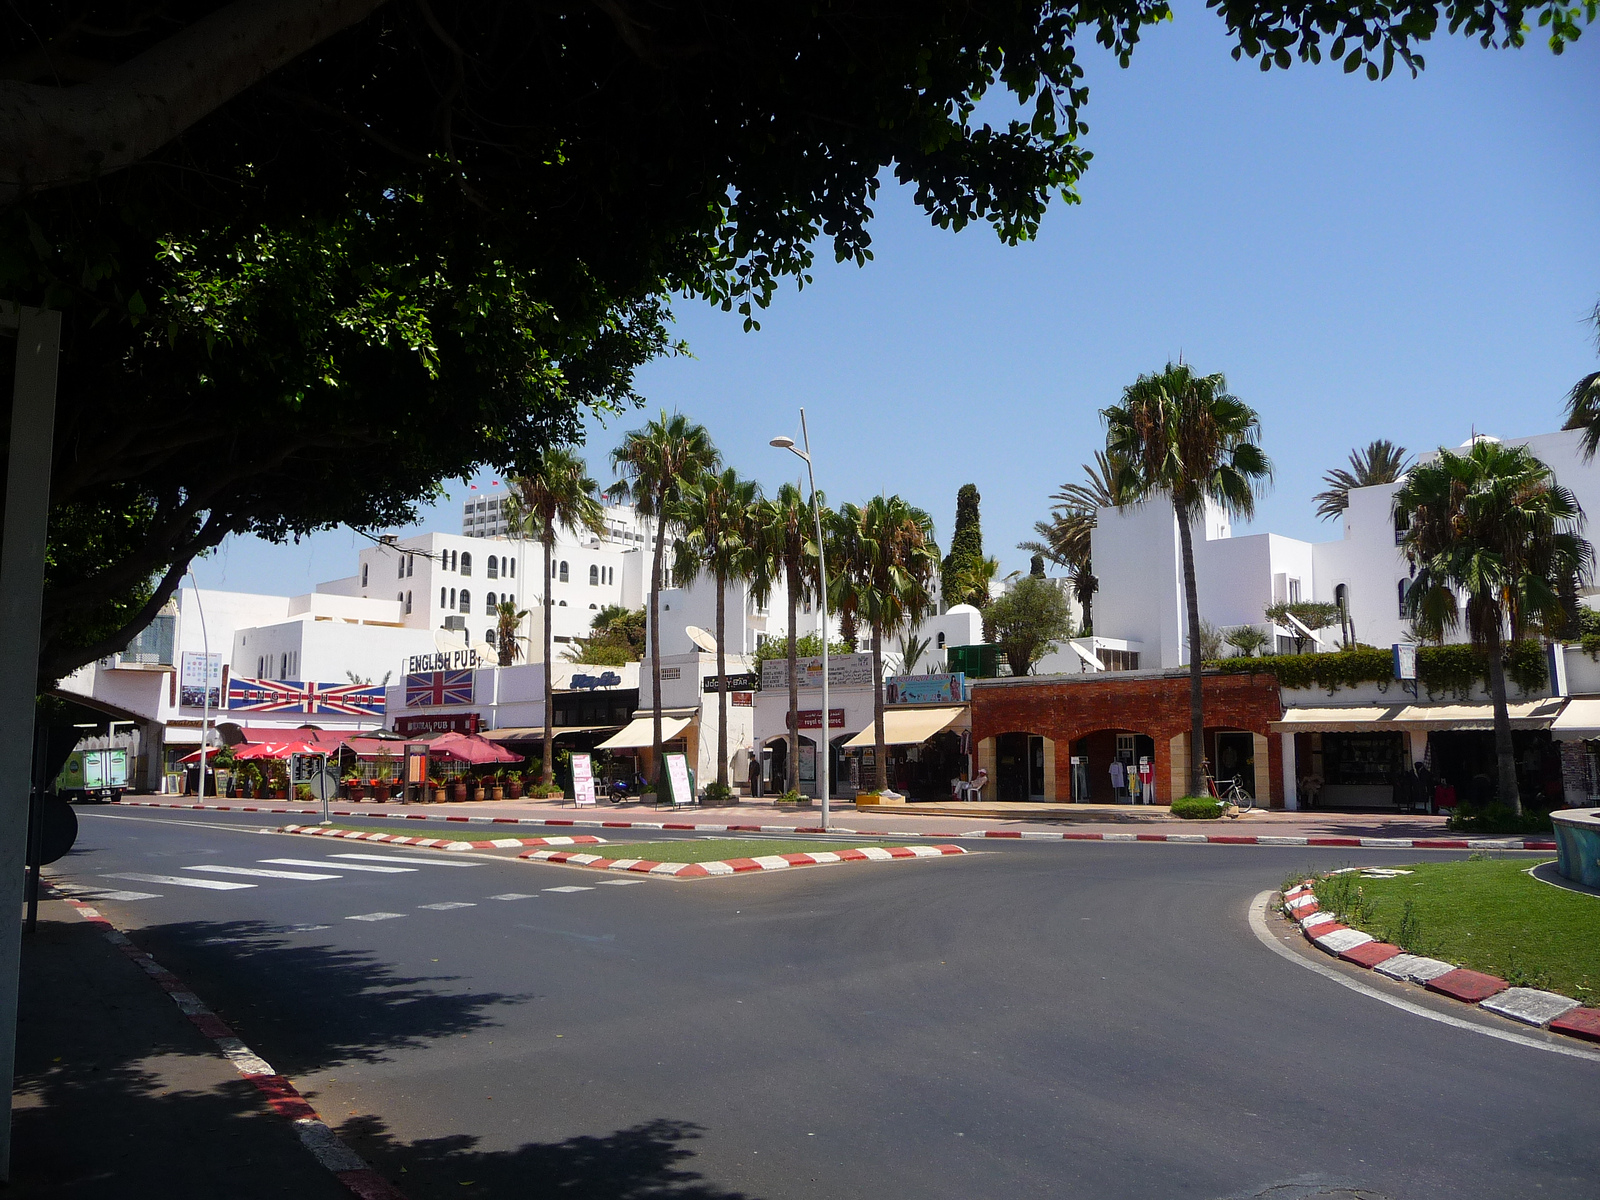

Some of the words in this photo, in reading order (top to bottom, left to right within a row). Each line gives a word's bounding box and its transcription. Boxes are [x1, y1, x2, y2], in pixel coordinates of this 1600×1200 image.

[409, 652, 451, 673] ENGLISH
[454, 649, 477, 670] PUB
[896, 675, 929, 683] BOUTIQUE
[705, 680, 732, 688] JOCY
[733, 679, 748, 687] BAR
[243, 689, 328, 703] ENGLISH
[341, 693, 374, 705] PUB
[434, 721, 448, 729] PUB
[804, 718, 817, 726] royal
